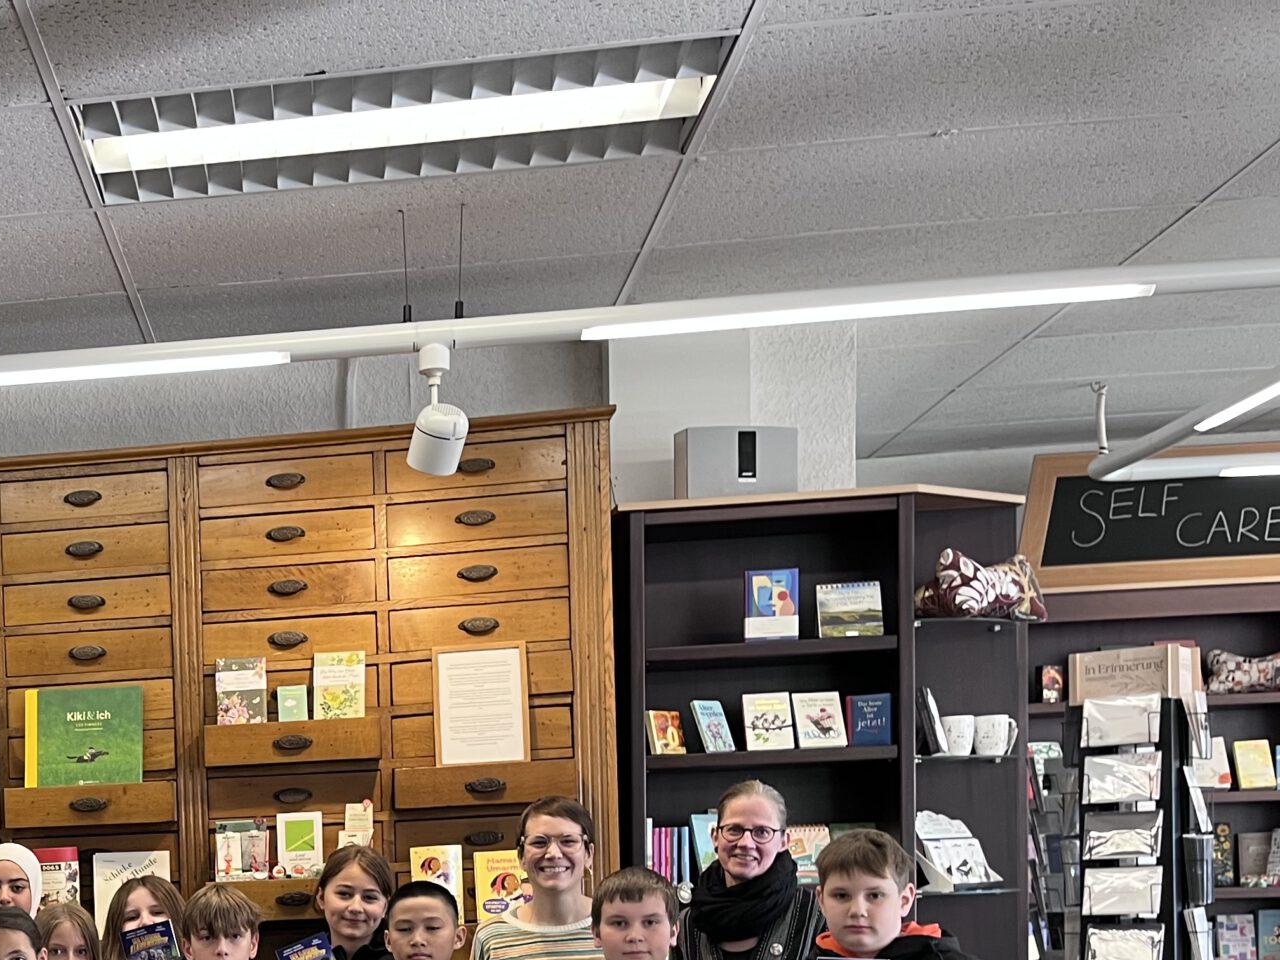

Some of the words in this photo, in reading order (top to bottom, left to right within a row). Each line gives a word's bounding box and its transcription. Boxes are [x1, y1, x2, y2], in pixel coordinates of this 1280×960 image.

[1072, 483, 1184, 548] SELF
[1176, 506, 1280, 547] CARE
[1084, 665, 1097, 676] In
[1097, 659, 1165, 675] Erinnerung
[66, 711, 86, 722] Kiki
[96, 710, 112, 720] ich
[855, 717, 887, 731] jetzt!
